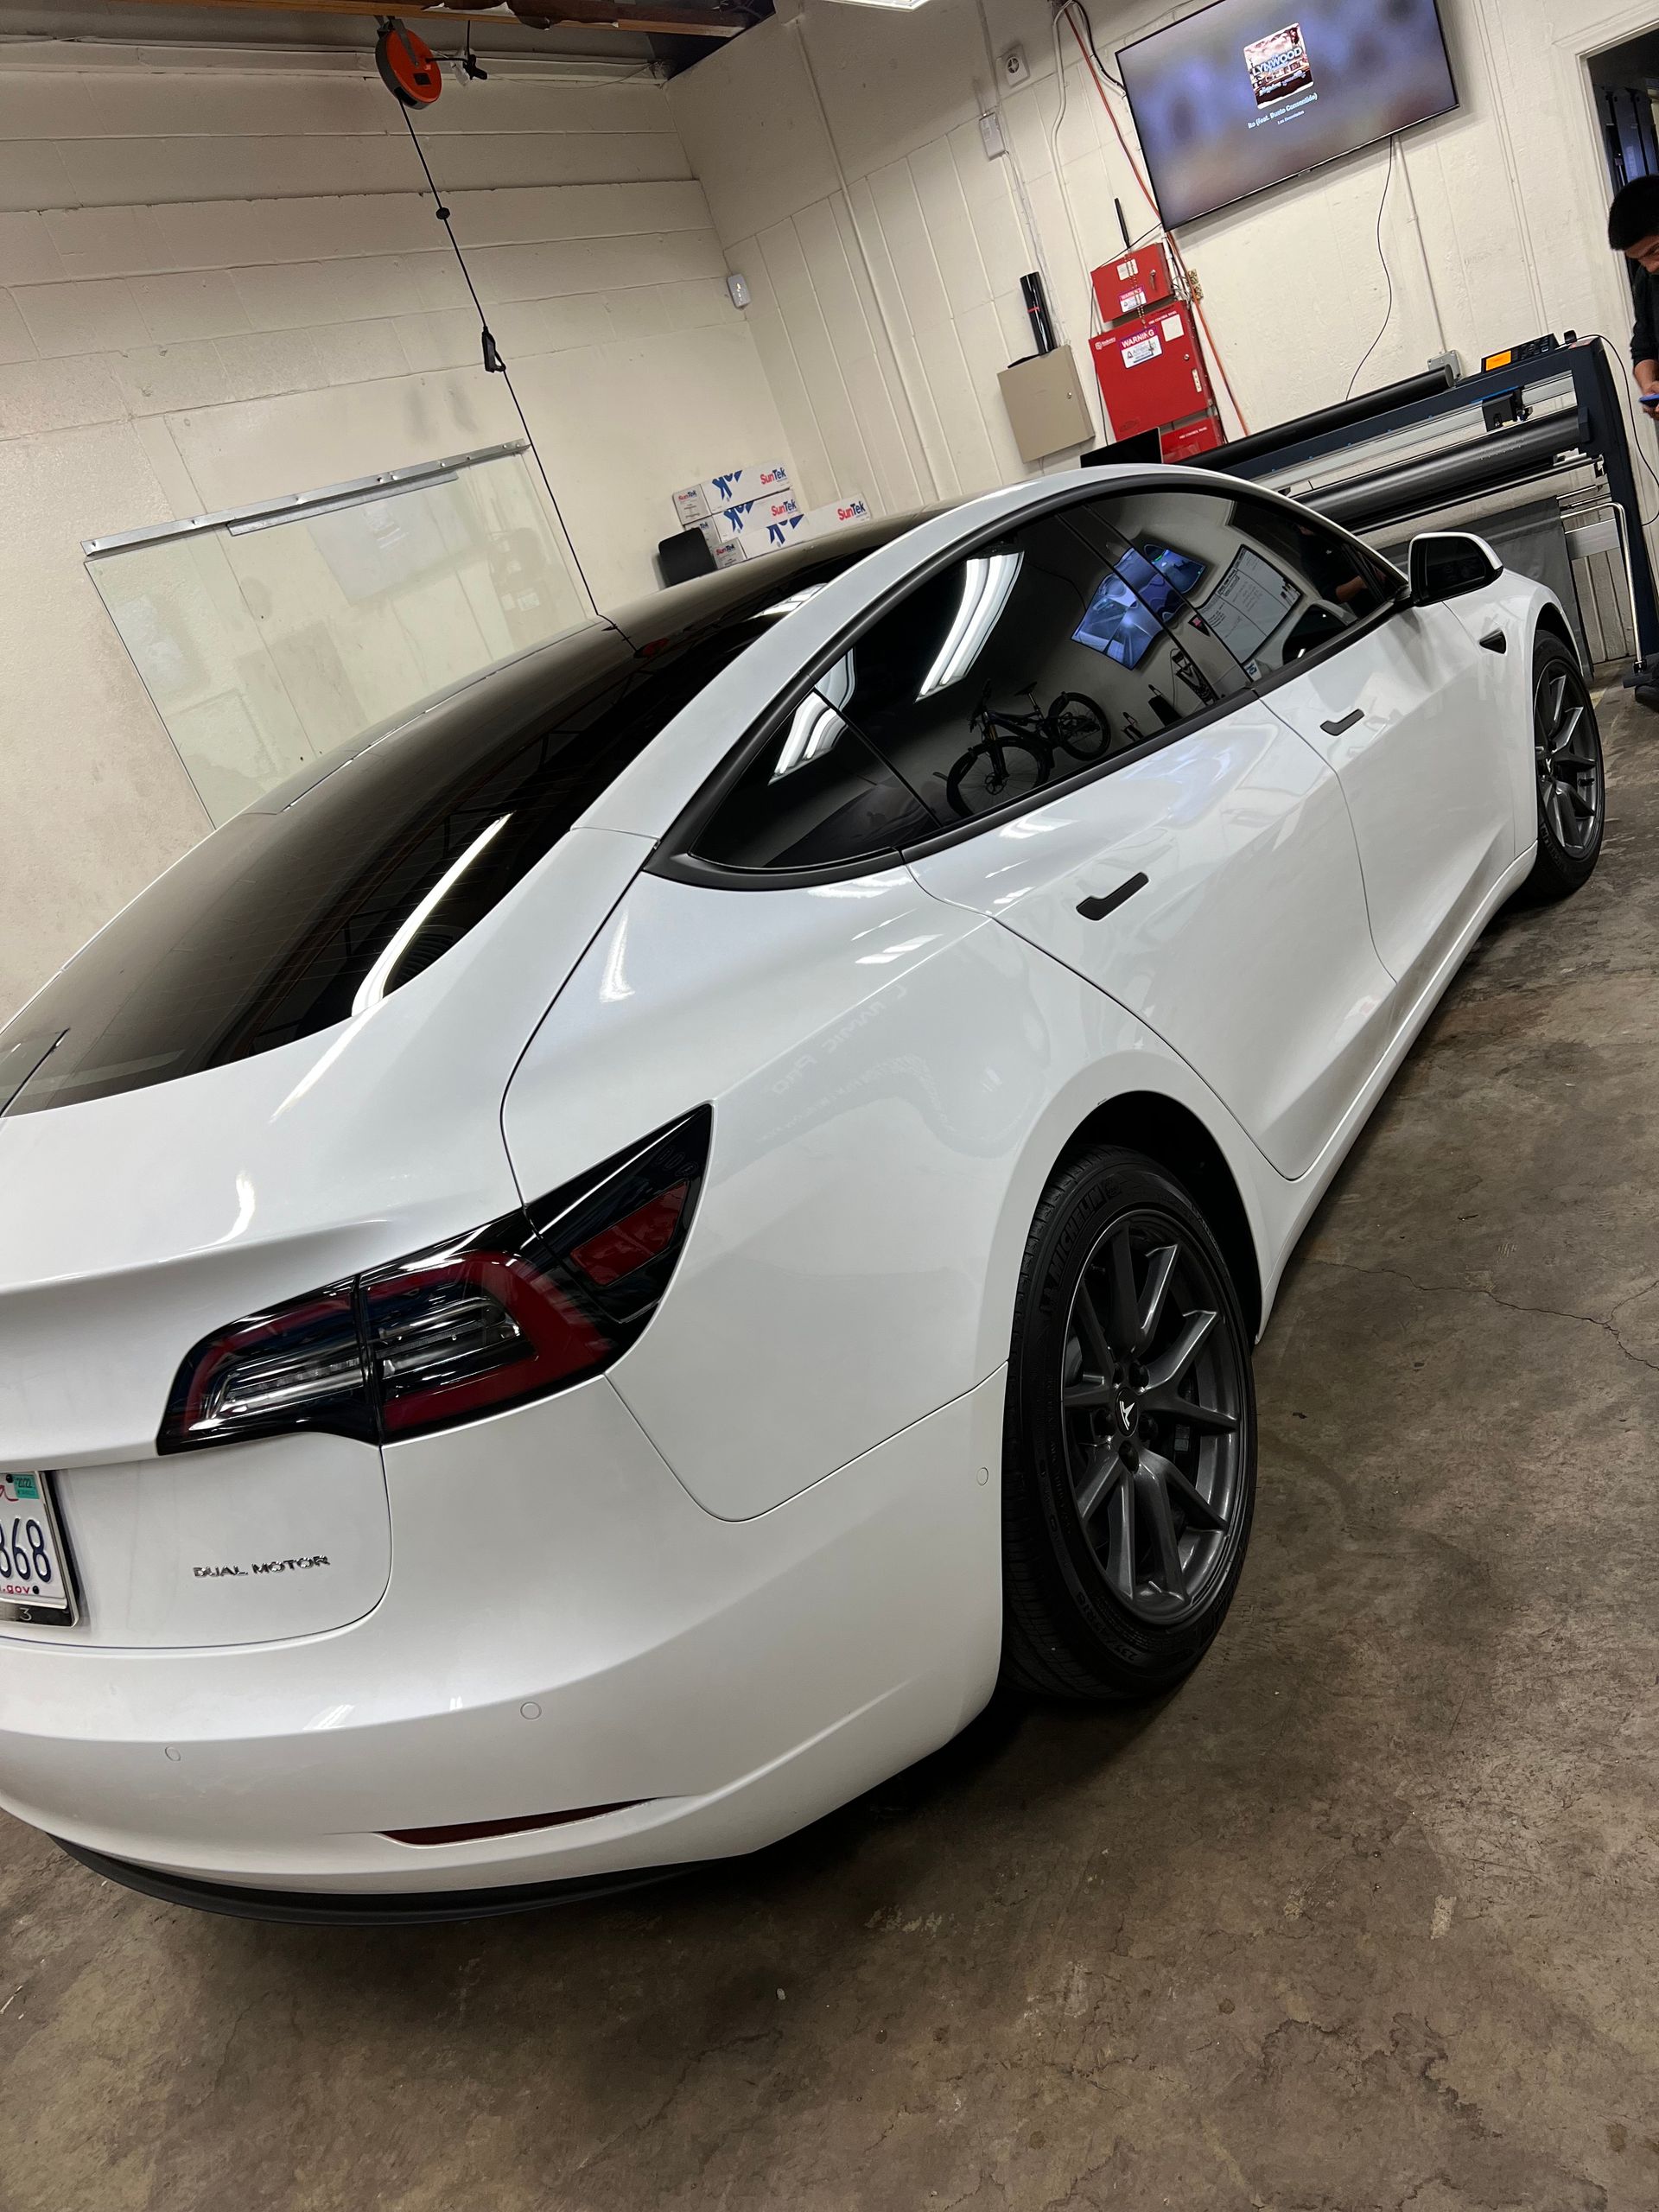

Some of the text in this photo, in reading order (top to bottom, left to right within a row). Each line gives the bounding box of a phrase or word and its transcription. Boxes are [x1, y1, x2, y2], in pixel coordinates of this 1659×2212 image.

[1251, 47, 1303, 77] LYNWOOD
[760, 467, 786, 485] SunTek
[771, 499, 798, 517] SunTek
[837, 501, 866, 521] SunTek
[1048, 1184, 1107, 1286] MICHELIN
[193, 1555, 330, 1578] DUAL MOTOR
[0, 1585, 30, 1594] .gov
[19, 1607, 32, 1621] 3
